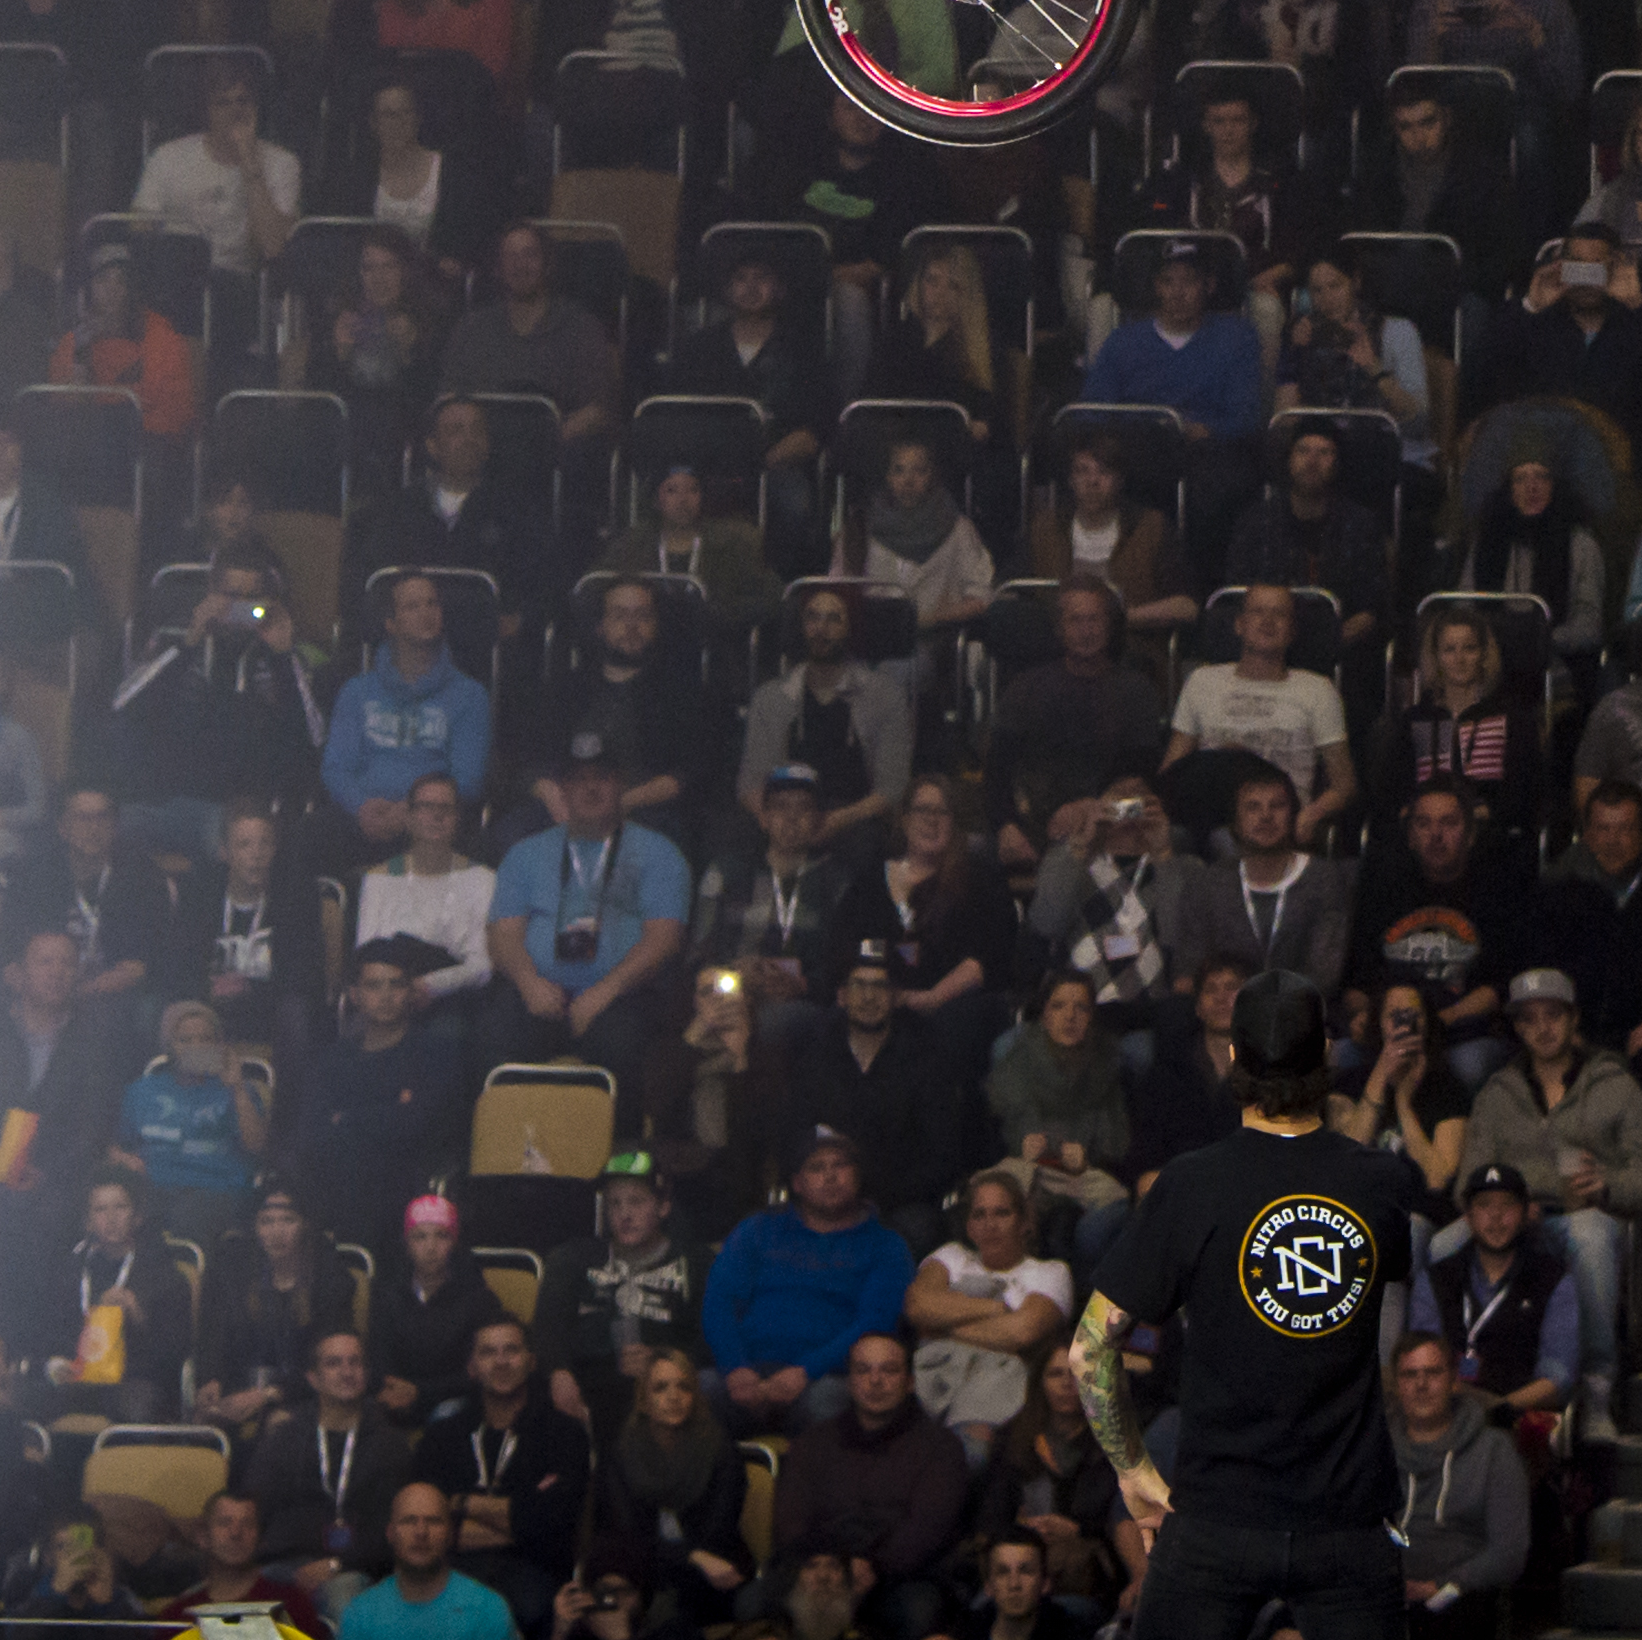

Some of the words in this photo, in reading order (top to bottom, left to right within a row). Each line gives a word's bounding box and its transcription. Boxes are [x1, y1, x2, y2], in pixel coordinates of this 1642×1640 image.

[1250, 1207, 1295, 1258] NITRO
[1297, 1205, 1365, 1249] CIRCUS
[1255, 1287, 1289, 1322] YOU
[1291, 1313, 1323, 1329] GOT
[1327, 1277, 1366, 1323] THIS!
